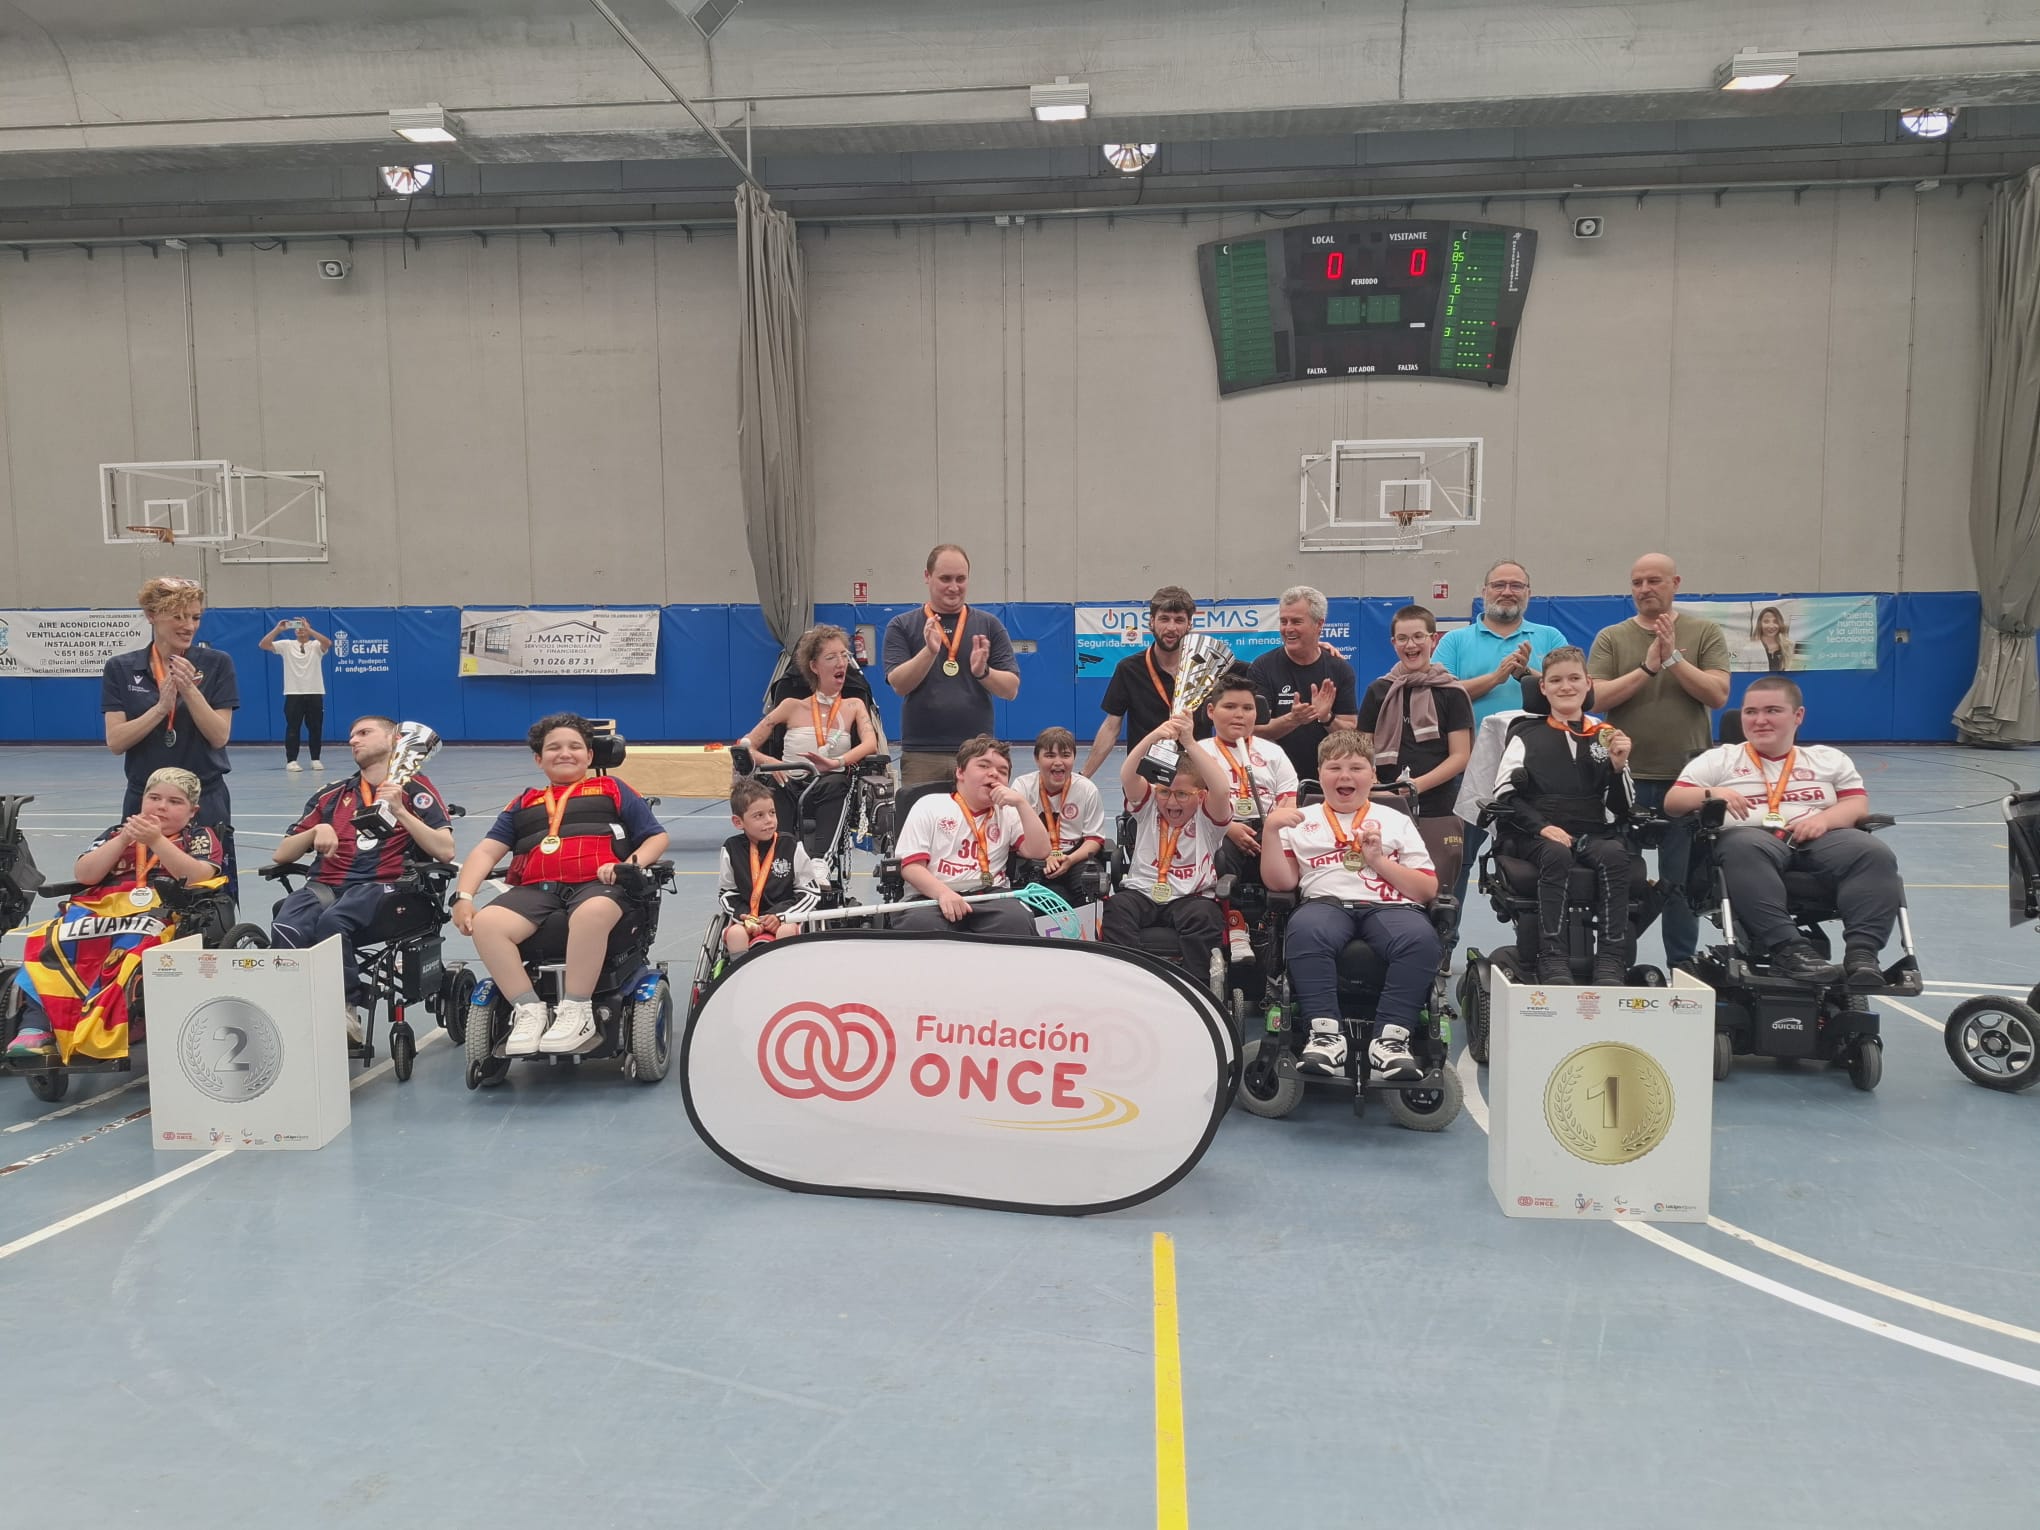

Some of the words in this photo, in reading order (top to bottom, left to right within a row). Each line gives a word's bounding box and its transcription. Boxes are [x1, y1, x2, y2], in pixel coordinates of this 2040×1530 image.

[1311, 236, 1336, 245] LOCAL
[1389, 231, 1428, 241] VISITANTE
[1327, 252, 1344, 279] 0
[1409, 249, 1427, 277] 0
[1351, 277, 1378, 286] PERIODO
[1306, 367, 1327, 375] FALTAS
[1398, 363, 1419, 371] FALTAS
[524, 632, 601, 643] J.MARTÍN
[1320, 627, 1350, 638] ETAFE
[44, 640, 97, 648] INSTALADOR
[1236, 637, 1245, 645] ni
[66, 916, 158, 938] LEVANTE
[915, 1013, 1090, 1055] Fundación
[212, 1026, 250, 1073] 2
[908, 1056, 1089, 1110] ONCE
[1586, 1075, 1621, 1129] 1
